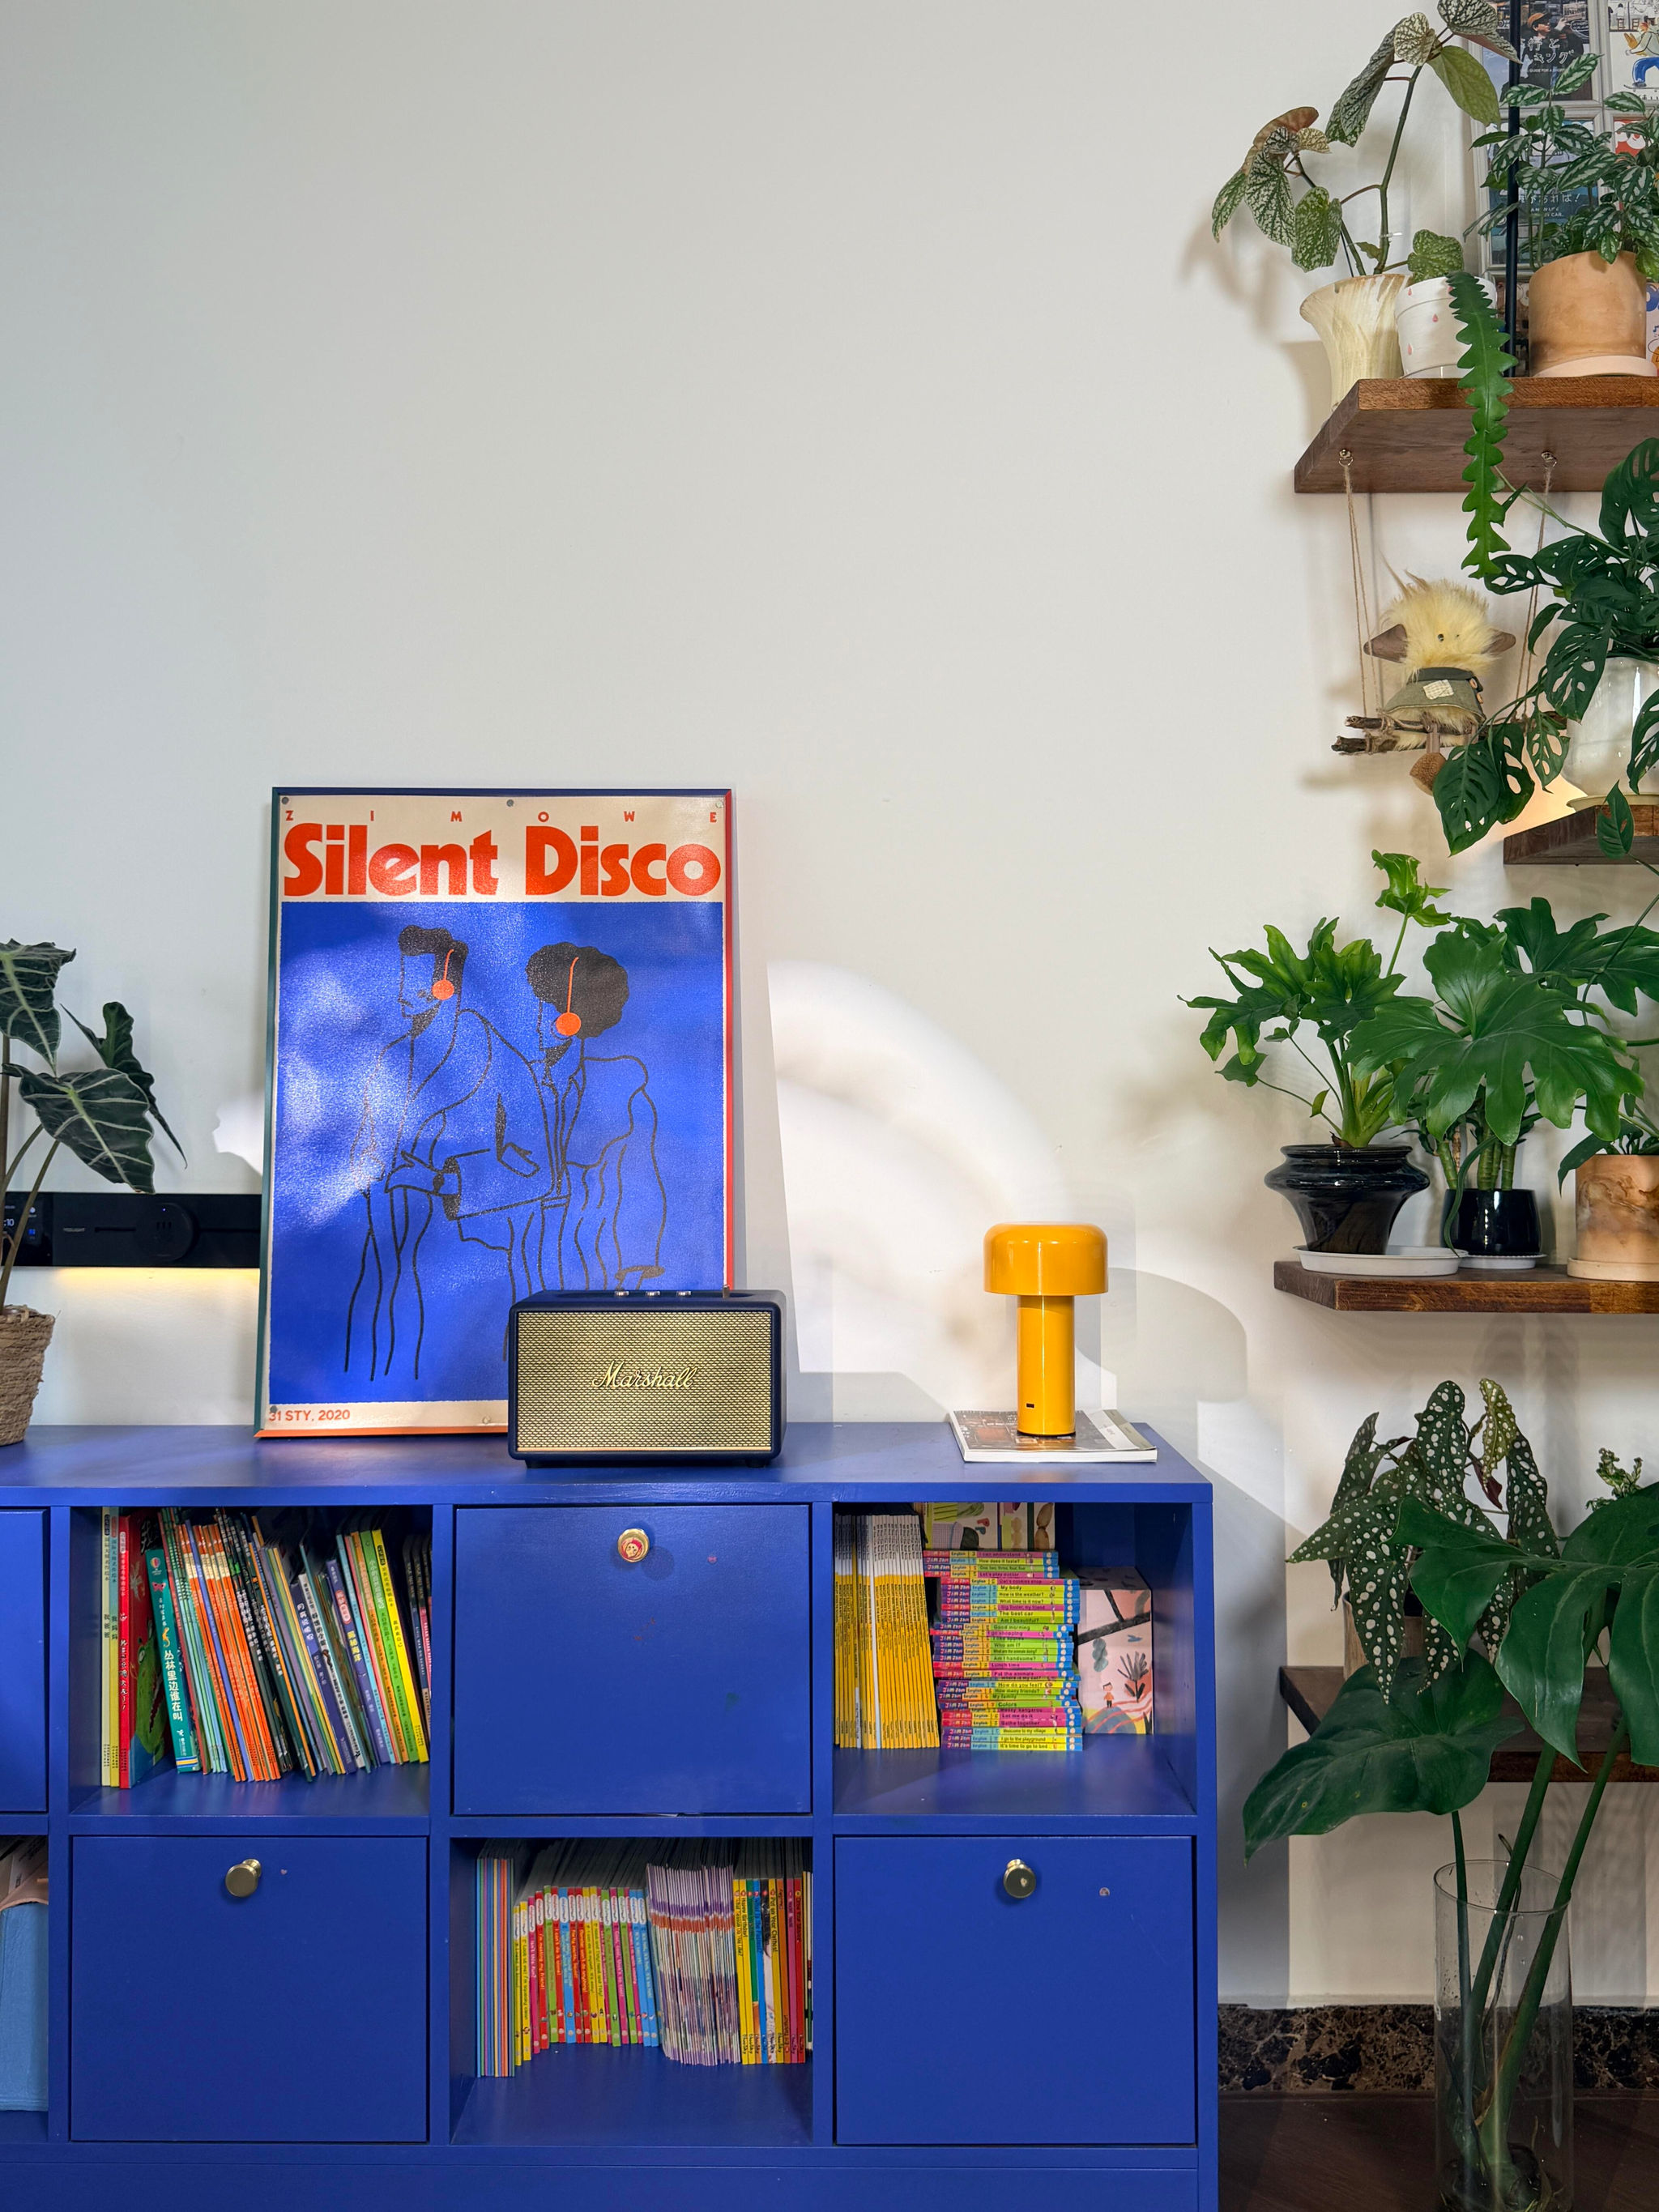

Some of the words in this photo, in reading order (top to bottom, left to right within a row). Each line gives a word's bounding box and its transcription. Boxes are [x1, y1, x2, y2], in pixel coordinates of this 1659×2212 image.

[284, 823, 499, 896] Silent
[525, 825, 721, 896] Disco
[591, 1360, 698, 1388] Marshall
[269, 1411, 281, 1421] 31
[285, 1410, 314, 1422] STY,
[318, 1409, 350, 1421] 2020
[164, 1650, 183, 1722] 丛林里边谁在叫
